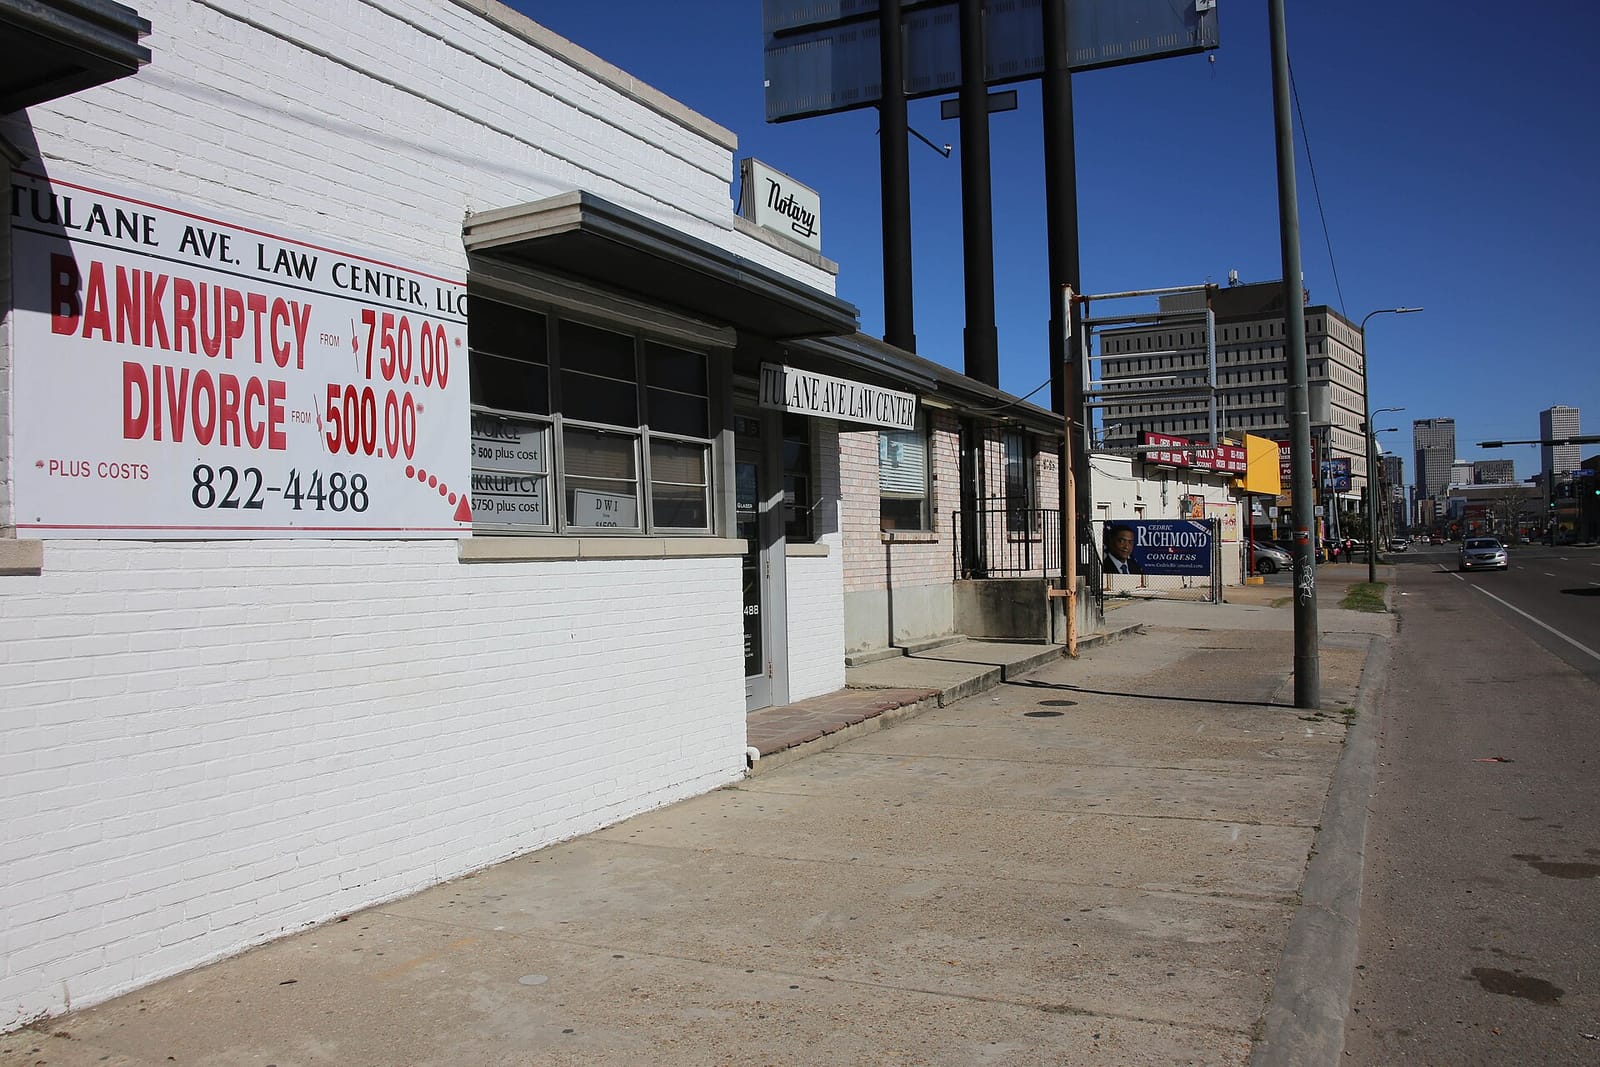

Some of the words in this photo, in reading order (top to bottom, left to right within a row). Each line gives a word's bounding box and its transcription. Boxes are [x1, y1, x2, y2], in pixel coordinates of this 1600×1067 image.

[766, 177, 818, 238] Notary
[12, 183, 159, 247] TULANE
[179, 225, 241, 266] AVE.
[257, 243, 318, 282] LAW
[331, 261, 428, 309] CENTER,
[436, 287, 467, 315] LLC
[50, 252, 312, 370] BANKRUPTCY
[319, 332, 340, 348] FROM
[122, 361, 287, 450] DIVORCE
[291, 410, 312, 424] FROM
[763, 367, 820, 411] TULANE
[822, 381, 845, 415] AVE
[849, 386, 875, 420] LAW
[876, 391, 914, 427] CENTER
[49, 460, 91, 477] PLUS
[97, 462, 149, 480] COSTS
[478, 447, 493, 458] 500
[495, 447, 515, 460] plus
[517, 450, 538, 460] cost
[191, 464, 369, 513] 822-4488
[472, 498, 494, 511] $750
[496, 500, 516, 514] plus
[518, 502, 540, 513] cost
